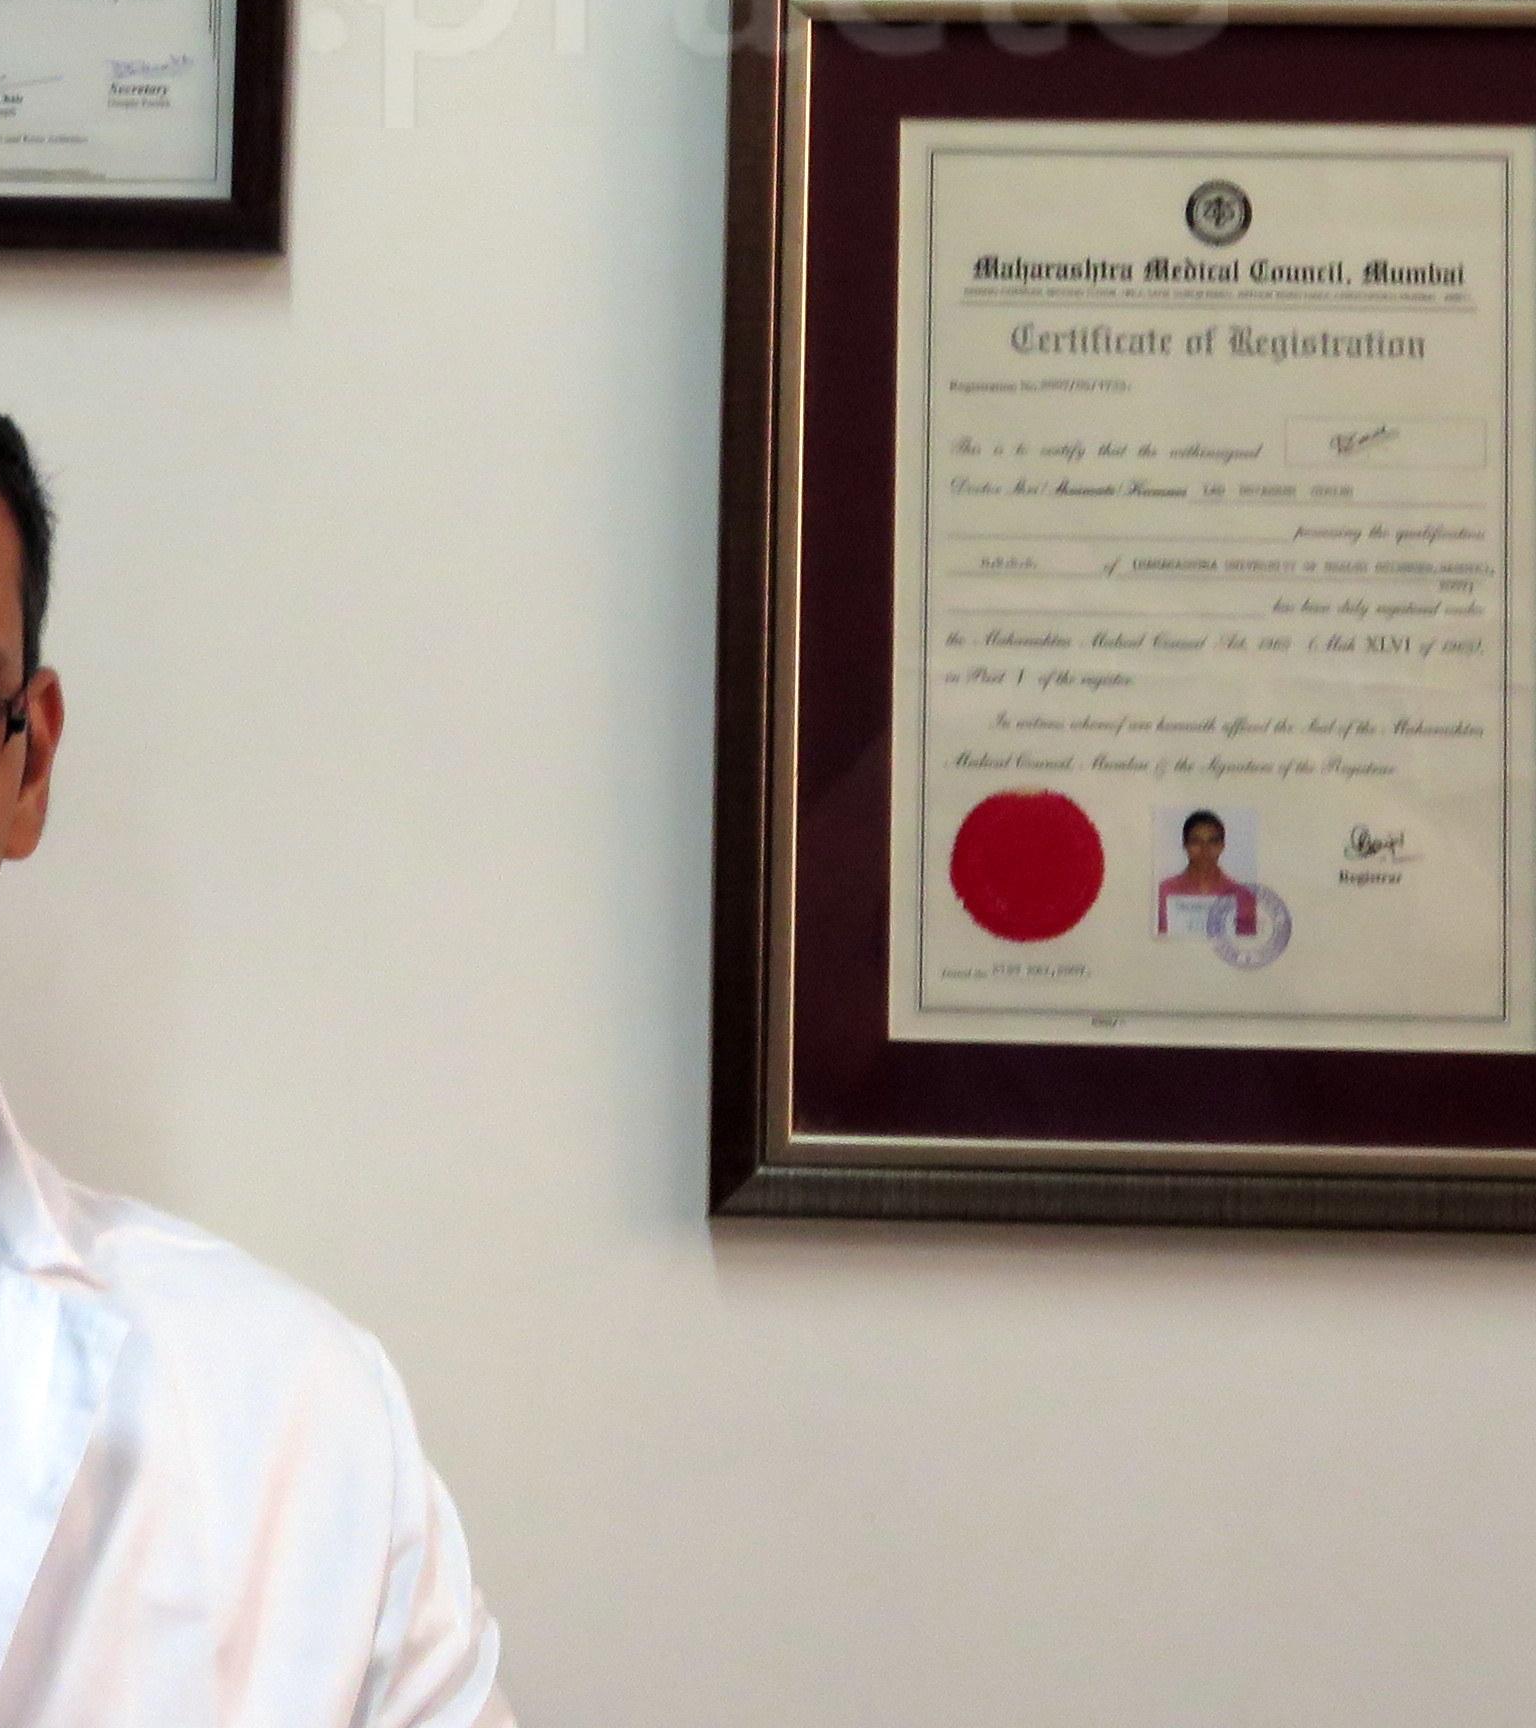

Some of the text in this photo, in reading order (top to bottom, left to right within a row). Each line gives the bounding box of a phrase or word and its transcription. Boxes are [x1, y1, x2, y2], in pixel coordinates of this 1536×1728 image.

[973, 254, 1466, 288] Maharashtra Medical Council, Mumbai
[1010, 321, 1427, 365] Certificate of Registration
